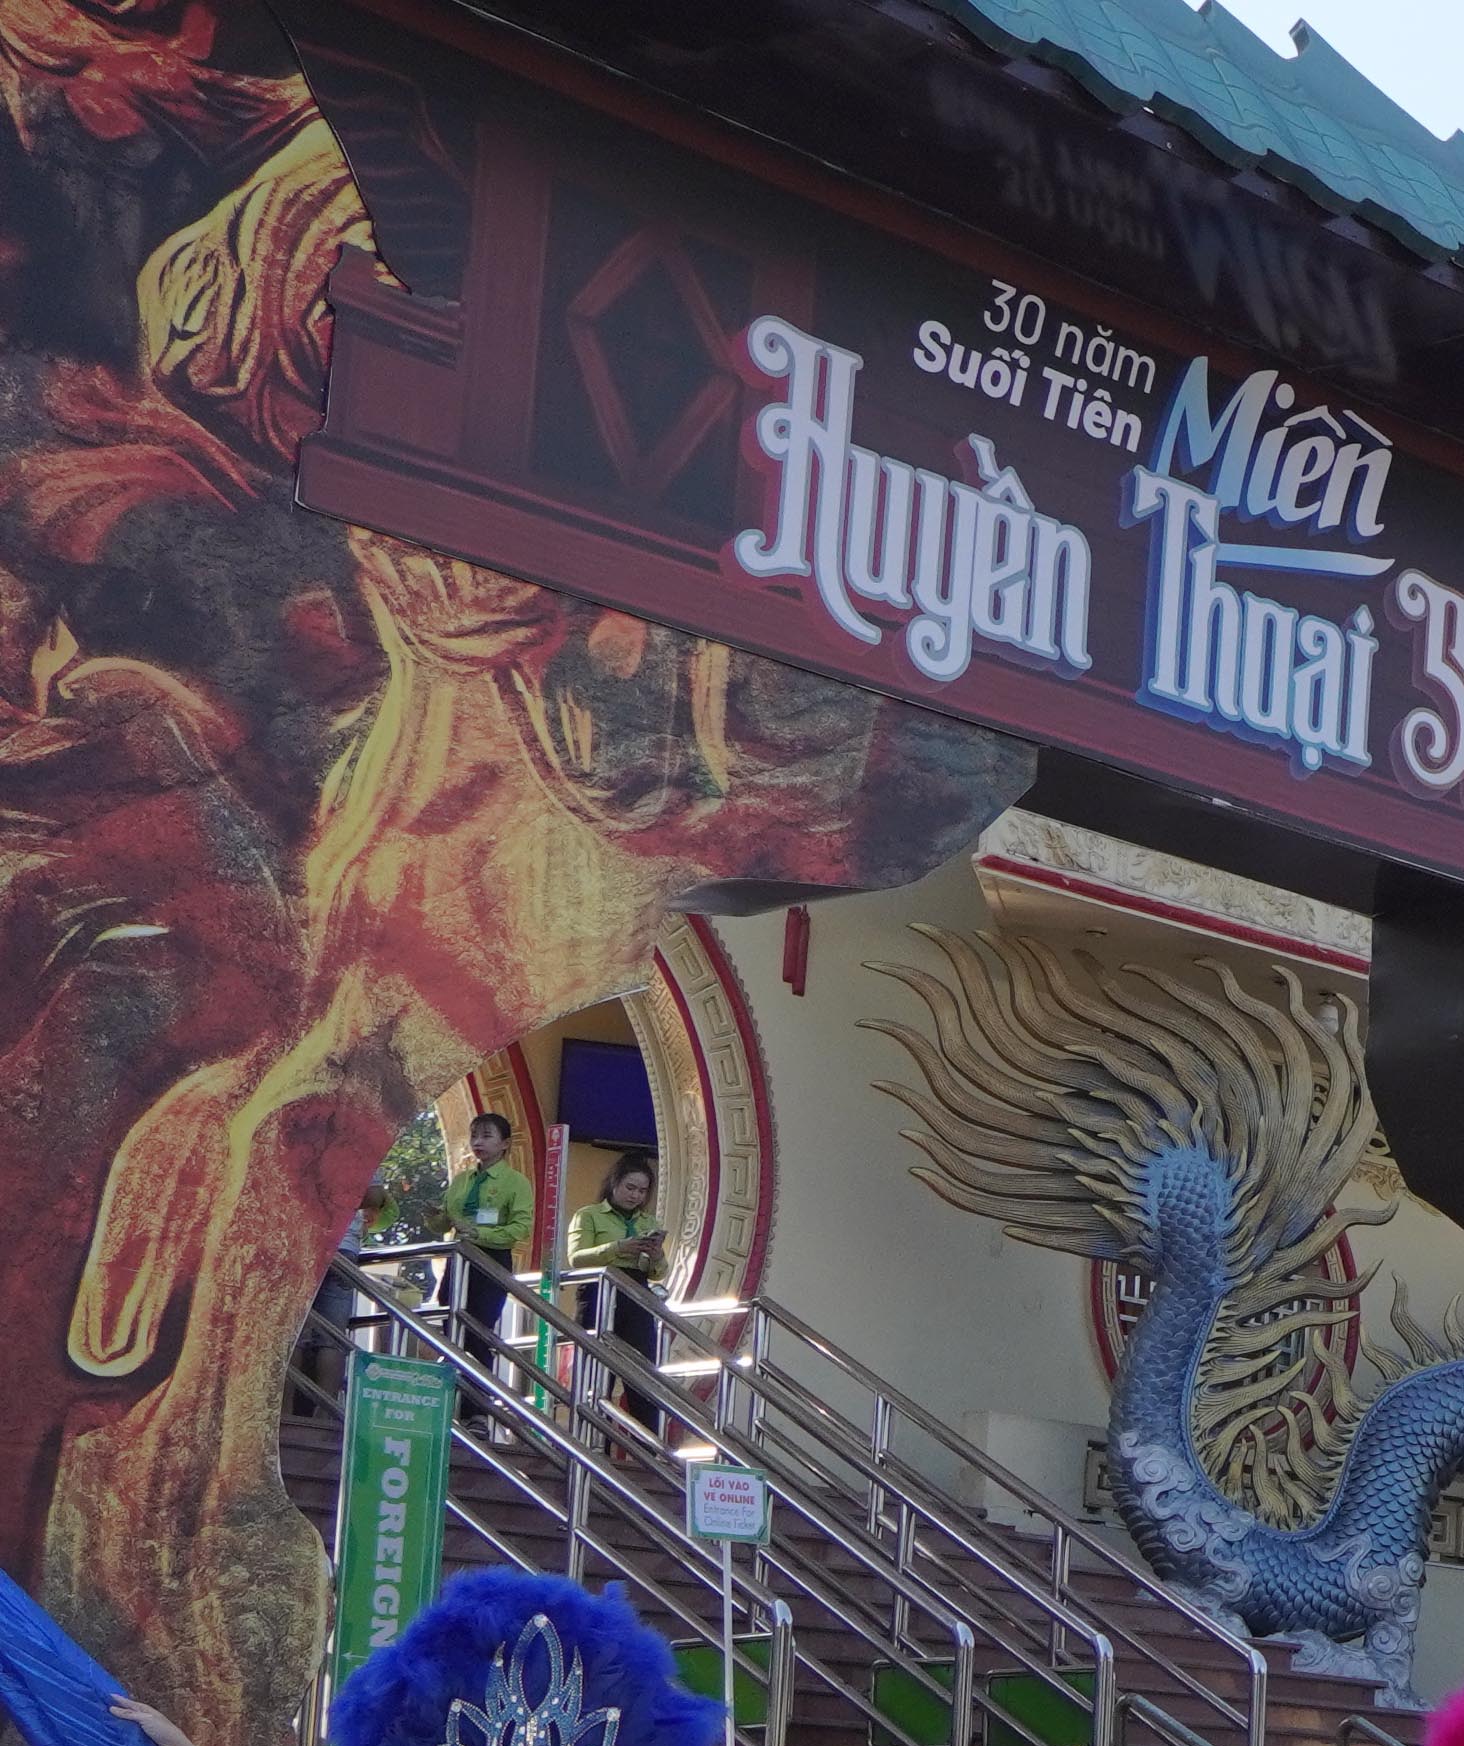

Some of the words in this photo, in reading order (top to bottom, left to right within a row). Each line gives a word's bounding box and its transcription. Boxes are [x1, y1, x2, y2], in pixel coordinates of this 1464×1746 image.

[913, 320, 1031, 407] Suối
[1042, 366, 1142, 453] Tiên
[984, 279, 1046, 345] 30
[1054, 324, 1156, 394] năm
[1155, 356, 1394, 537] Miền
[735, 315, 1093, 682] Huyền
[1133, 464, 1380, 771] Thoại
[362, 1387, 441, 1408] ENTRANCE
[384, 1408, 416, 1421] FOR
[369, 1436, 412, 1649] FOREIGN
[719, 1493, 755, 1505] ONLINE
